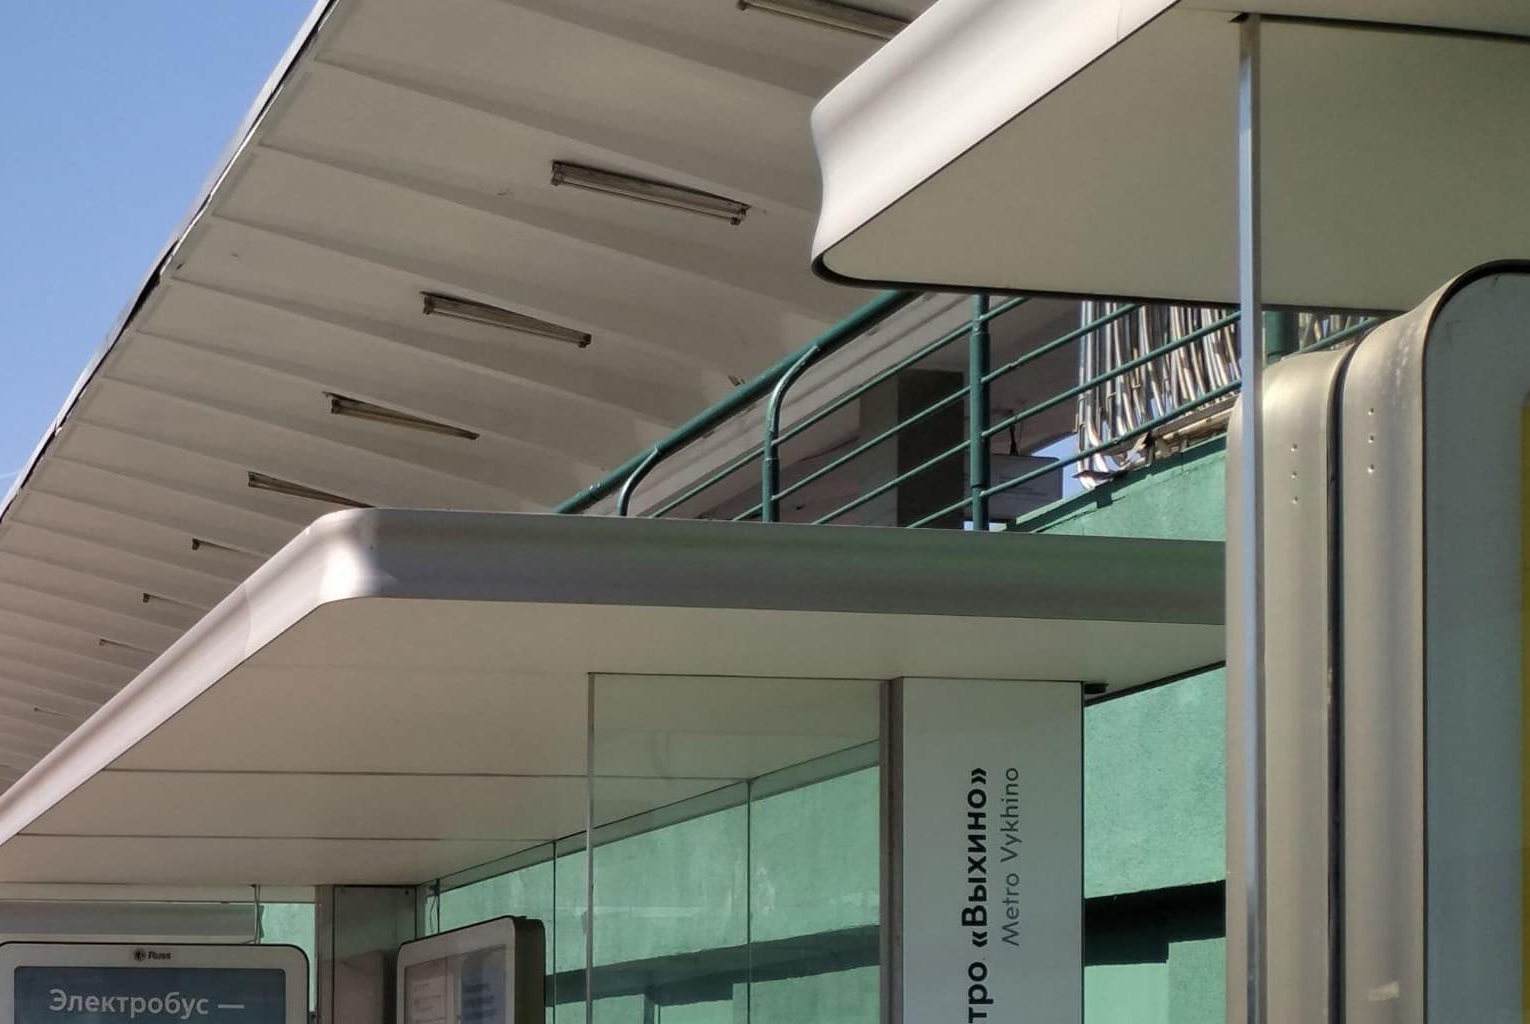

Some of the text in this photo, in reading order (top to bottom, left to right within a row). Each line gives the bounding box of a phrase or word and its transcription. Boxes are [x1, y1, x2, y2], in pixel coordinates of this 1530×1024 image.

[961, 767, 988, 948] «Выхино»
[999, 767, 1022, 946] Metro Vykhino
[48, 988, 210, 1020] Электробус
